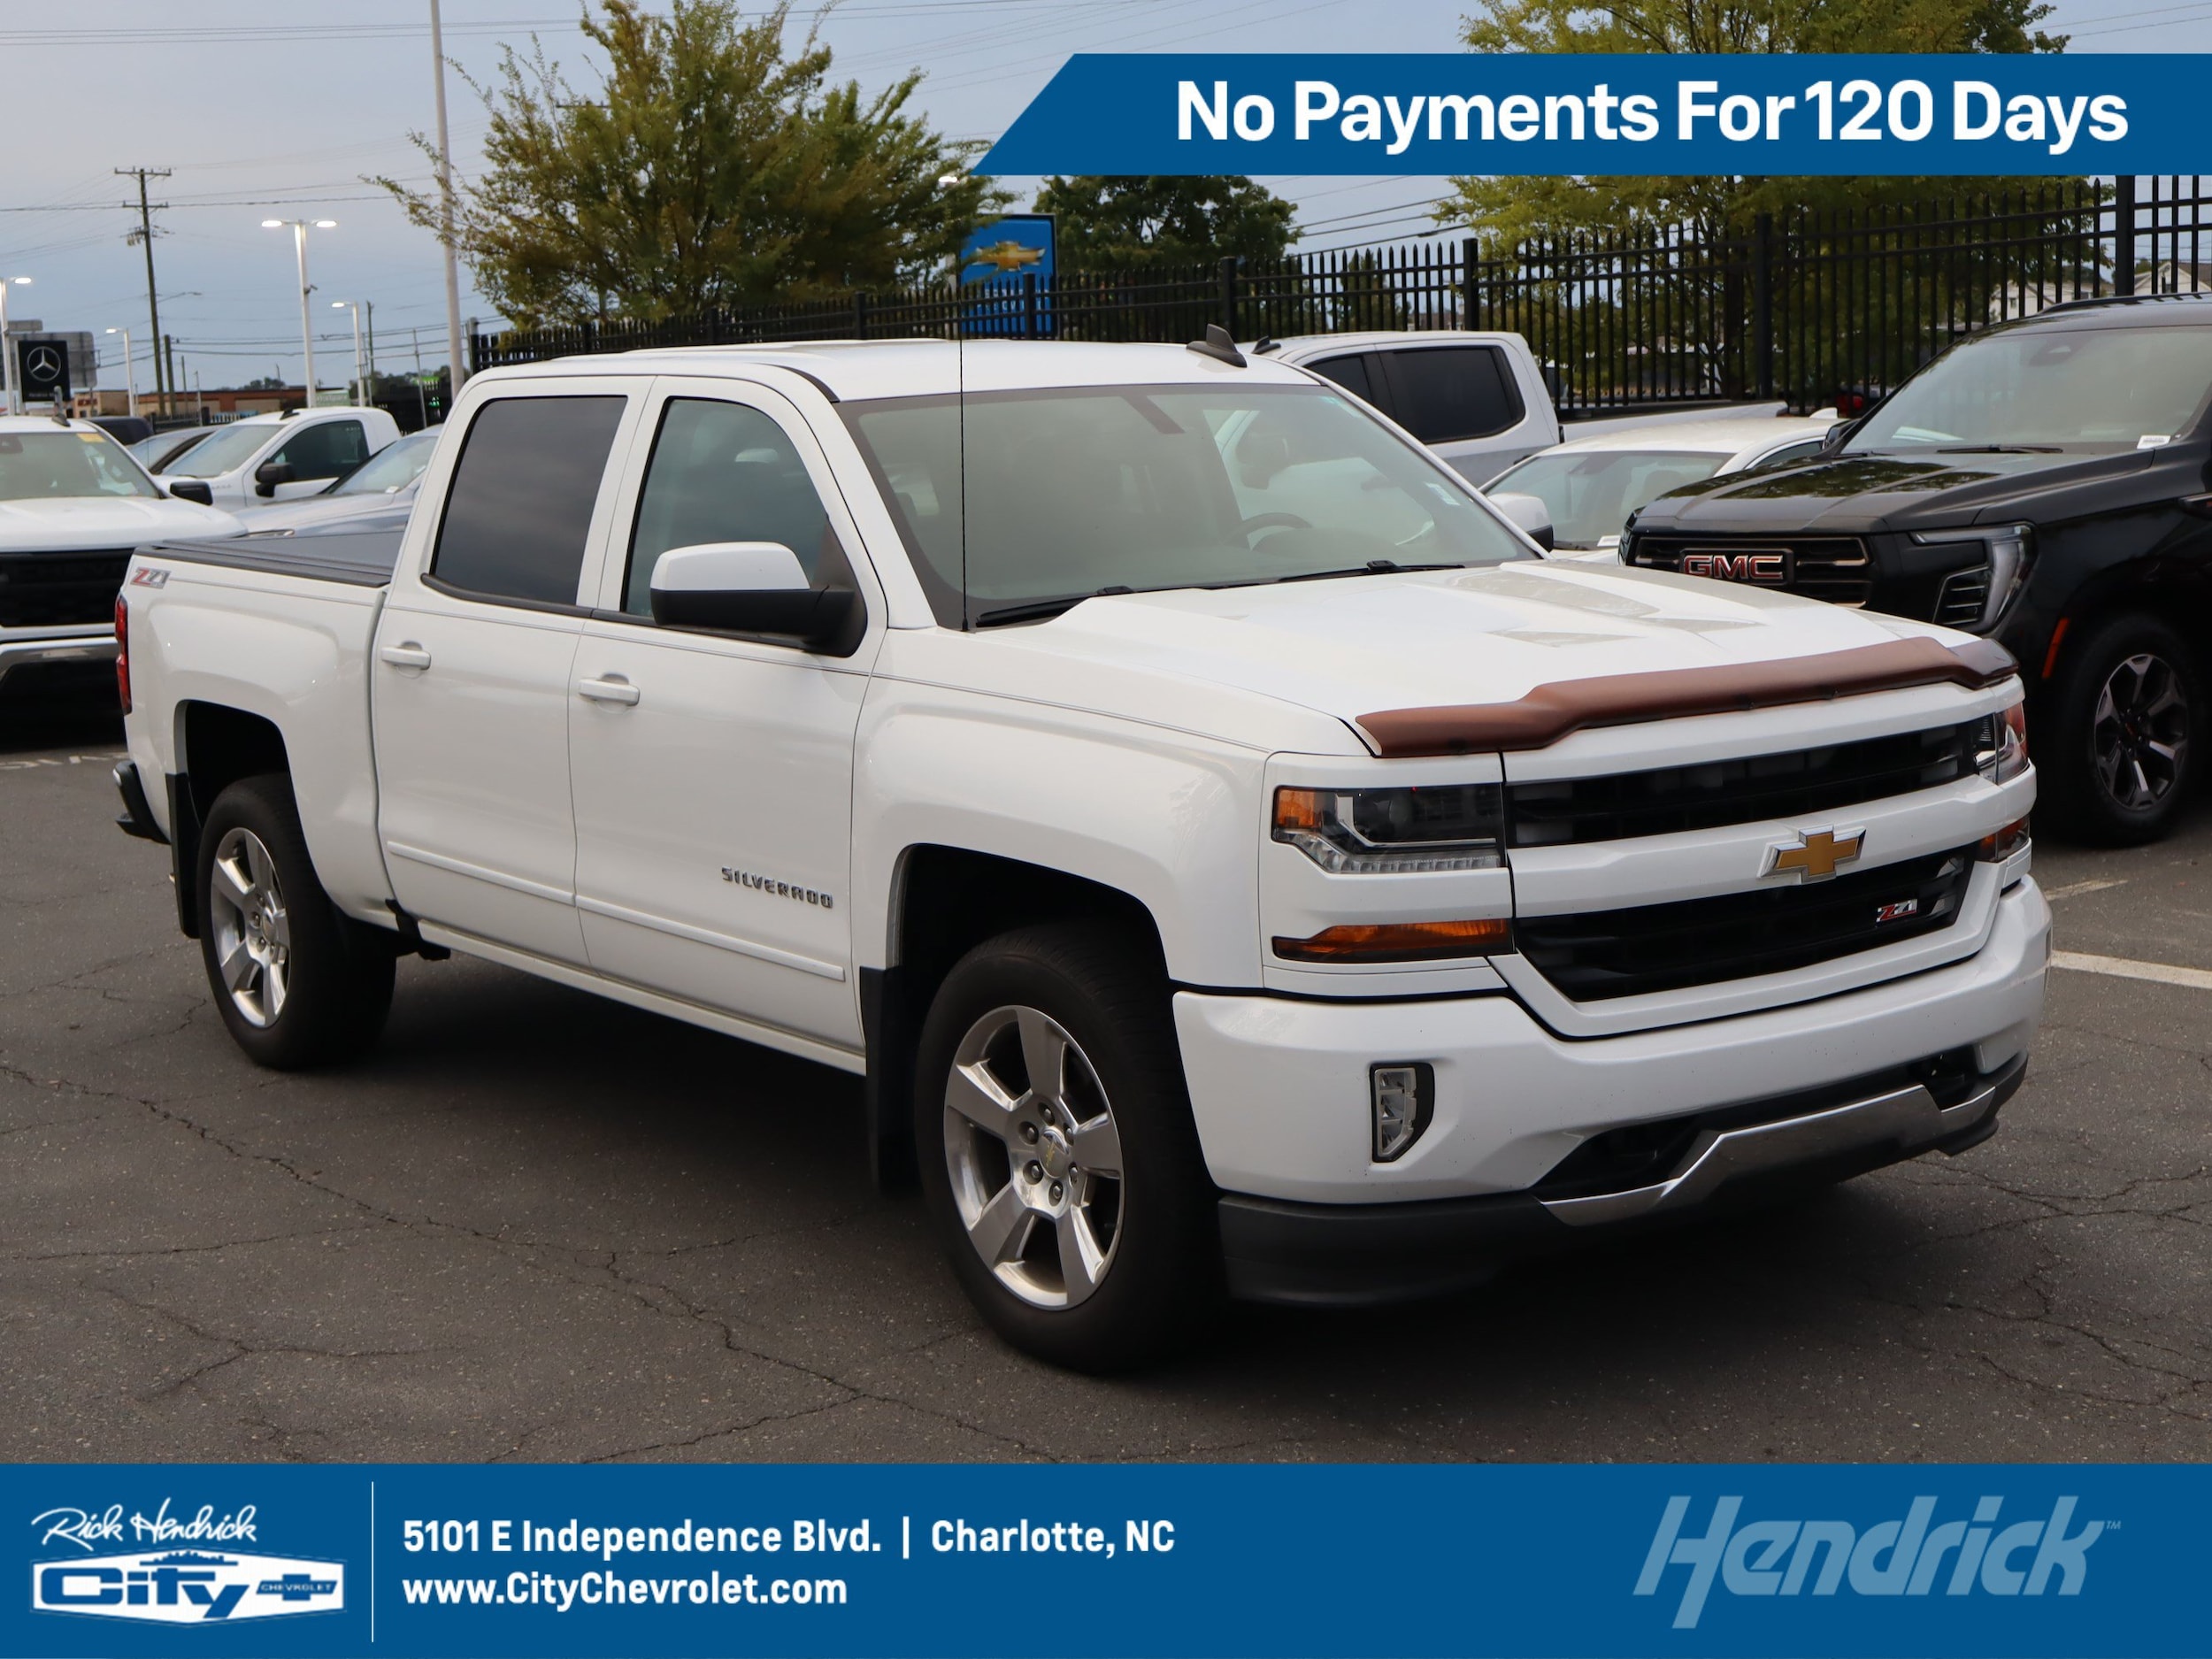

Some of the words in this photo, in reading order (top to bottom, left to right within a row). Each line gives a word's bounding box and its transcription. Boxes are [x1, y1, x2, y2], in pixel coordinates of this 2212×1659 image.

[131, 566, 171, 589] Z71
[1683, 555, 1784, 580] GMC
[721, 866, 833, 909] SILVERADO
[1876, 898, 1918, 922] Z71
